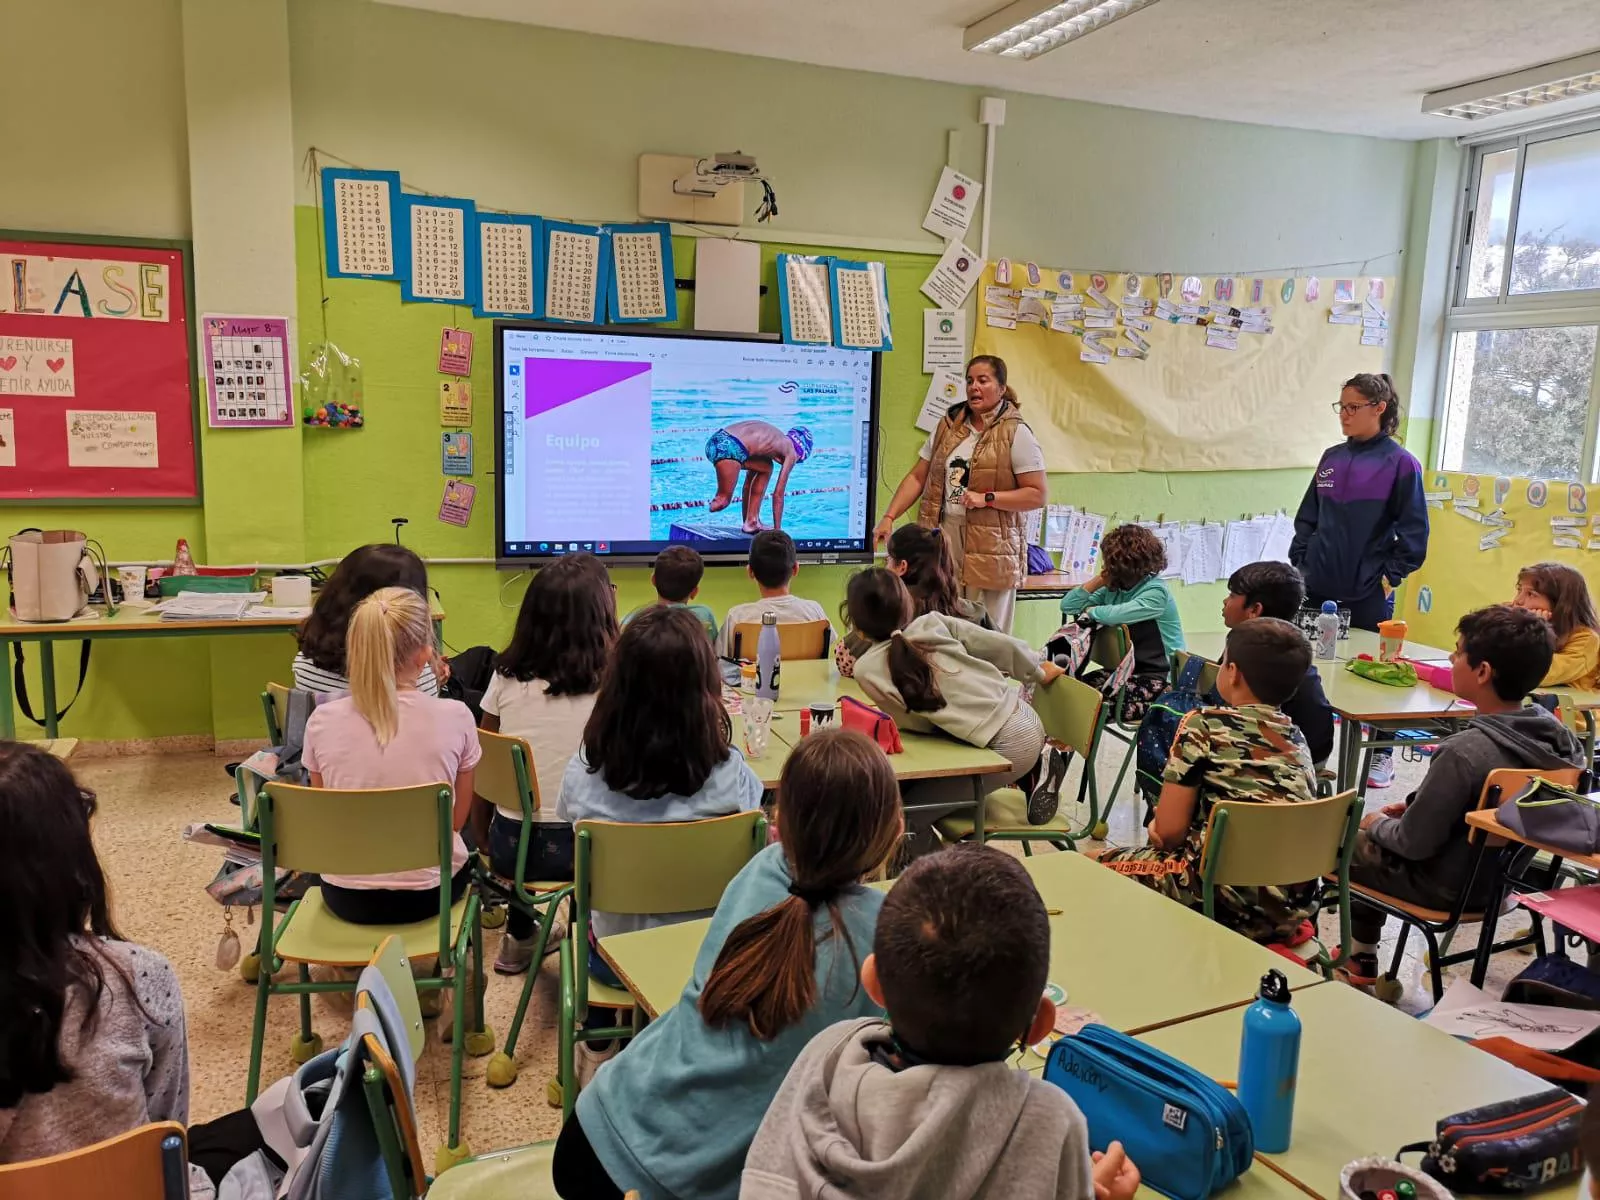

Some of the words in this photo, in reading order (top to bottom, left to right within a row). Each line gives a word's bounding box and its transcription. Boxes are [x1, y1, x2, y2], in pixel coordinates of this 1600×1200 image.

[0, 259, 163, 317] LASE
[1059, 273, 1072, 290] C
[1215, 278, 1234, 300] H
[445, 331, 450, 340] 1
[22, 354, 33, 372] Y
[444, 434, 451, 442] 3
[546, 434, 600, 451] Equipo
[1494, 477, 1510, 504] P
[1527, 480, 1547, 507] Q
[1568, 483, 1587, 513] R
[1418, 587, 1432, 612] Ñ
